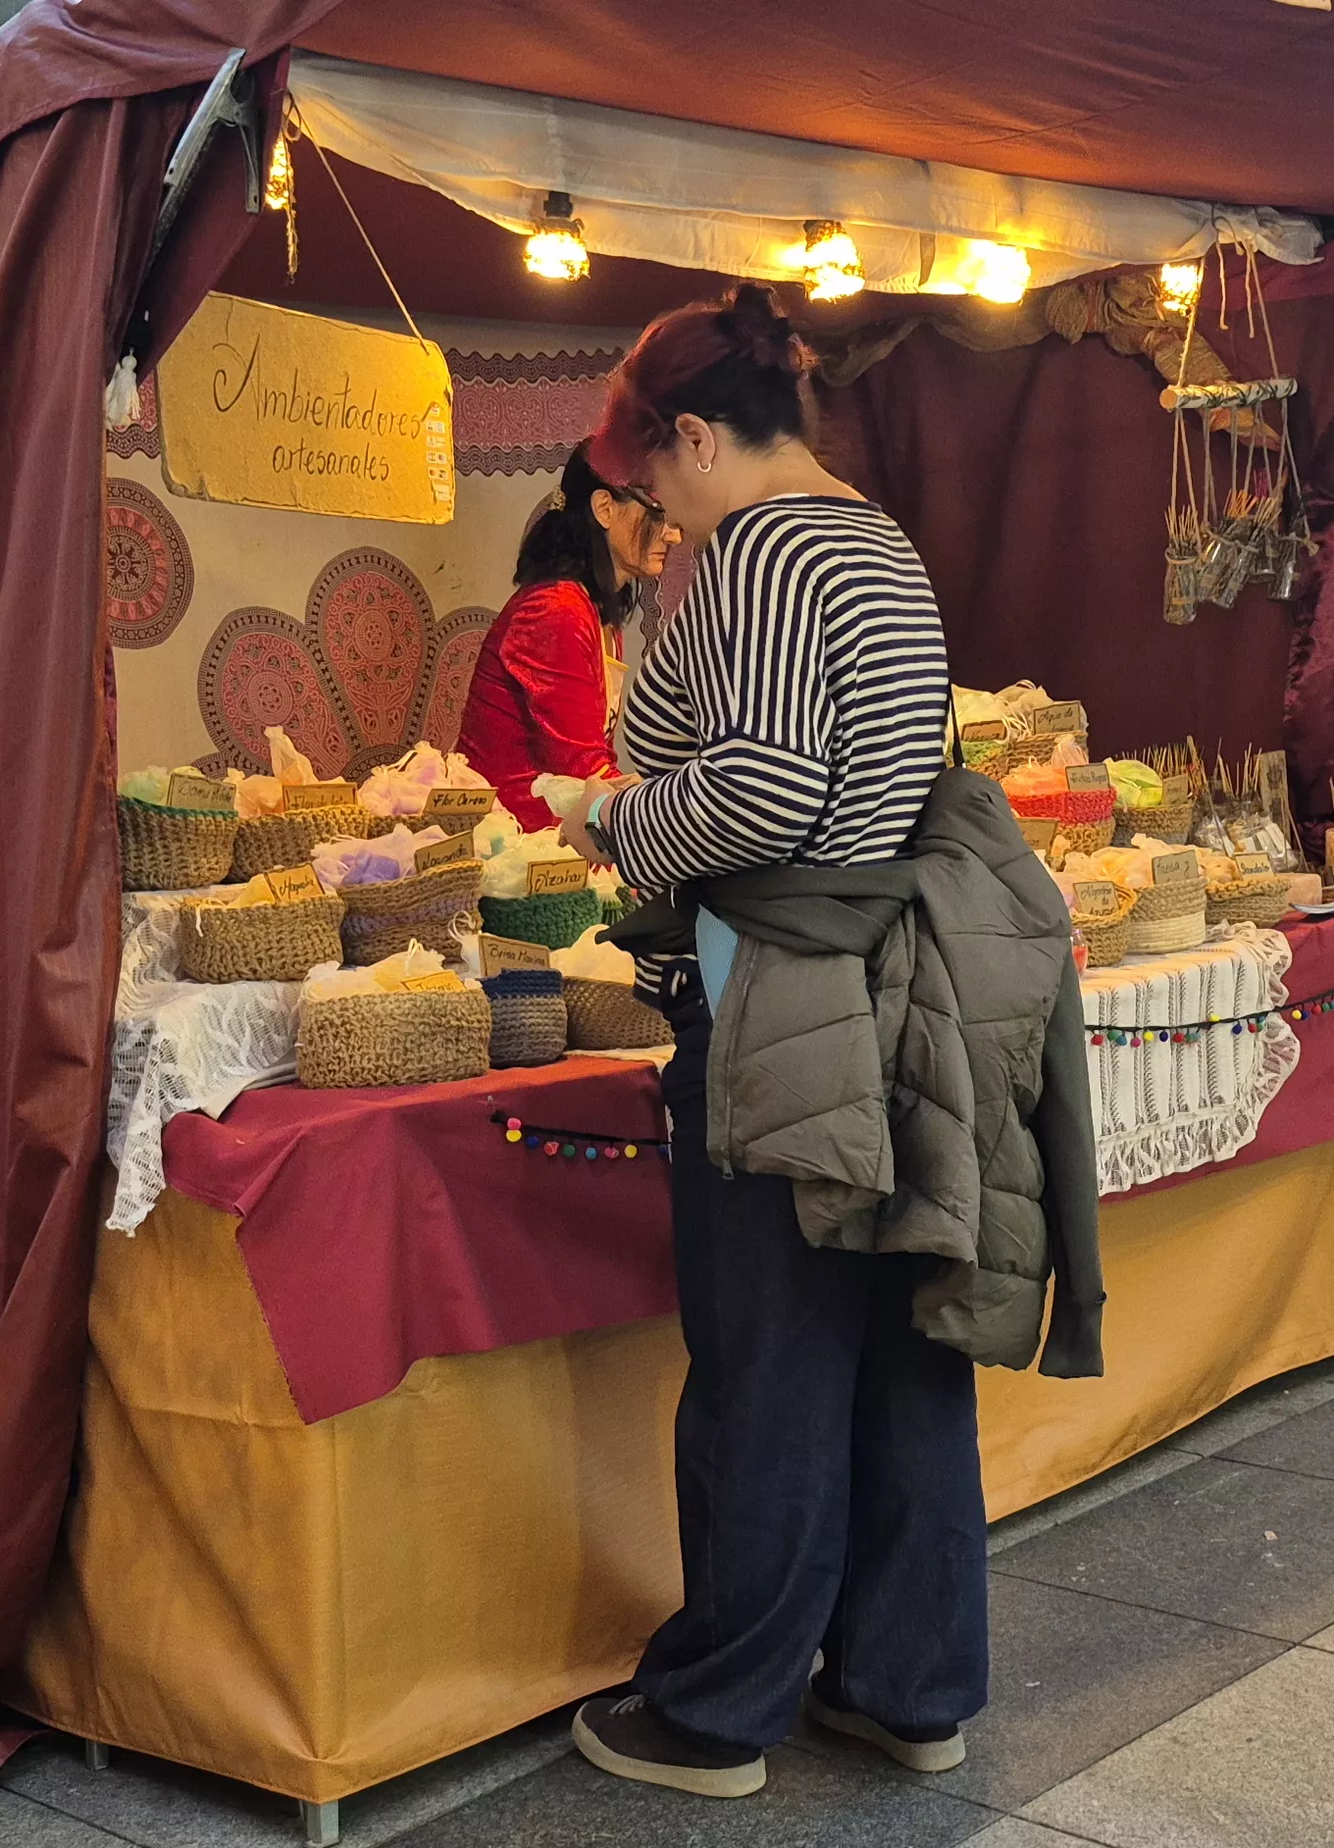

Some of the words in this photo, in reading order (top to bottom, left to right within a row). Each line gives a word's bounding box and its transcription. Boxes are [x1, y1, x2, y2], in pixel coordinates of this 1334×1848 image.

[212, 333, 433, 439] Ambientadores
[272, 436, 389, 481] artesanales
[432, 793, 455, 808] Flor
[534, 869, 586, 893] Azahar
[487, 943, 516, 960] Brisa
